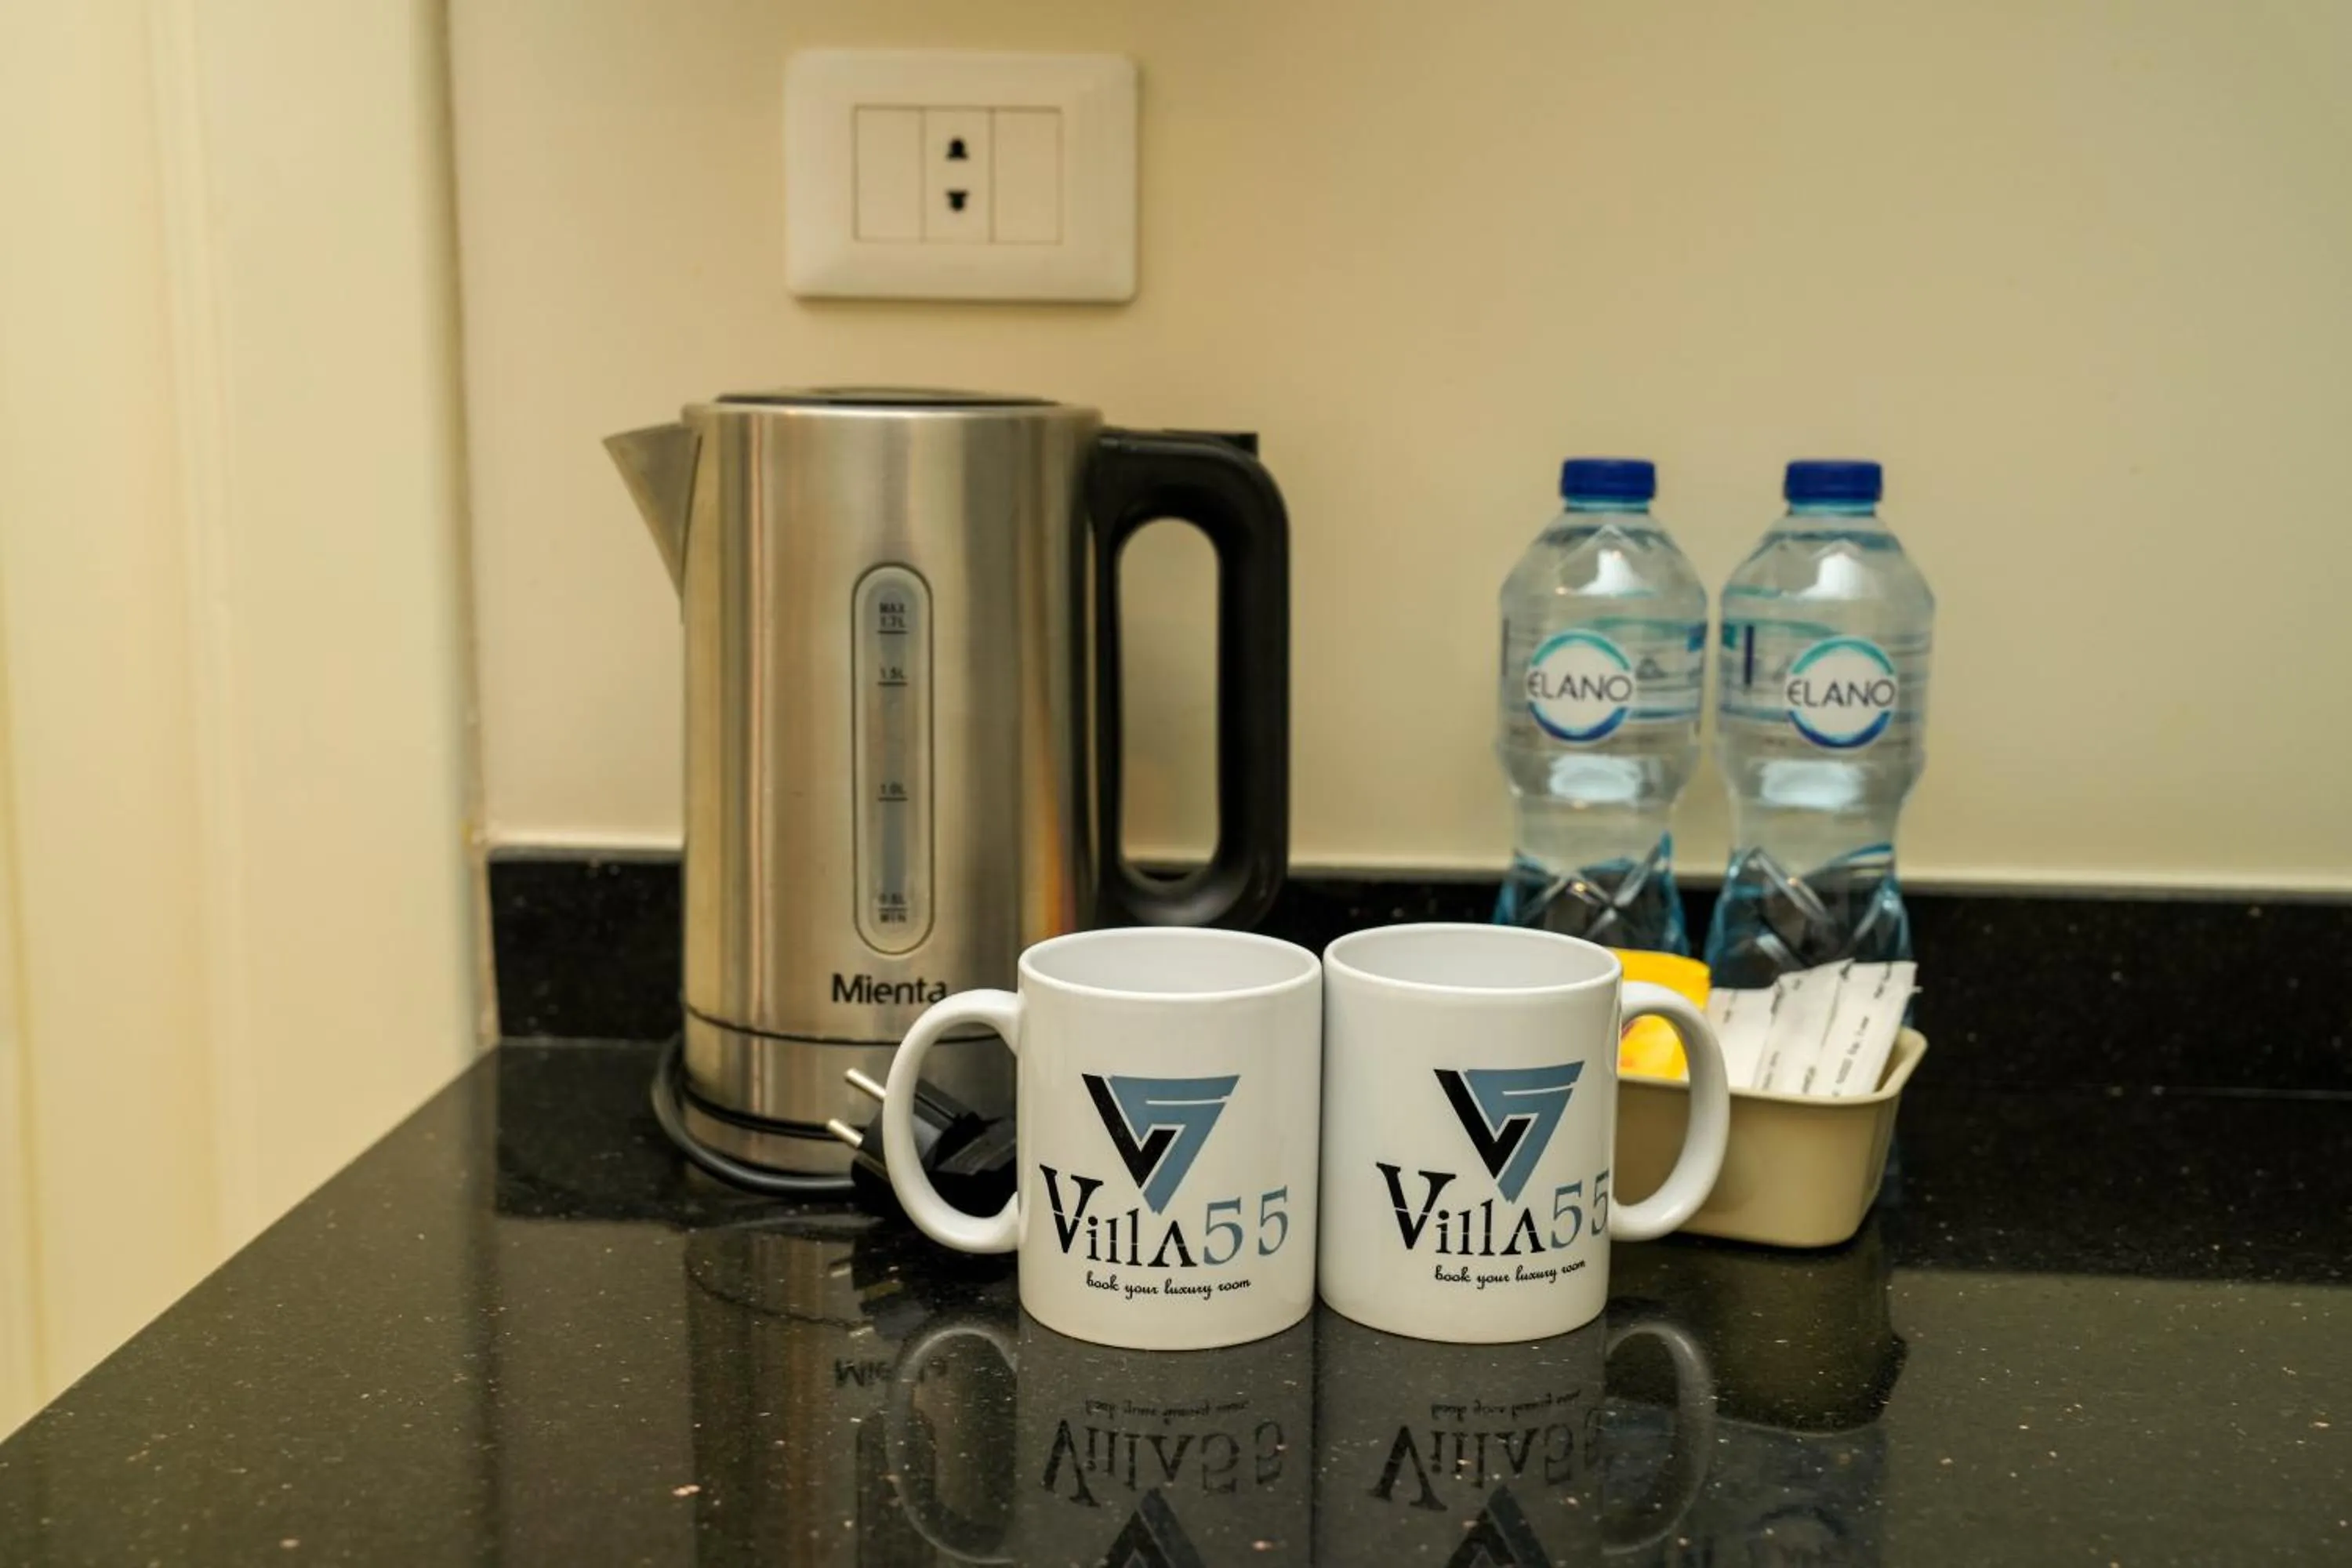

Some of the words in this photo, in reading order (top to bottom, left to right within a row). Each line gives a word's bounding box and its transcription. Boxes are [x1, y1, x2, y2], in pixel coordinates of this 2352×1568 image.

[1528, 671, 1632, 702] ELANO
[1787, 679, 1896, 707] ELANO
[832, 972, 947, 1004] Mienta
[1086, 1271, 1120, 1291] book
[1124, 1283, 1159, 1300] your
[1164, 1279, 1212, 1300] luxury
[1219, 1279, 1252, 1292] room
[1435, 1265, 1472, 1282] book
[1476, 1272, 1510, 1290] your
[1515, 1265, 1558, 1284] luxury
[1560, 1259, 1587, 1273] room
